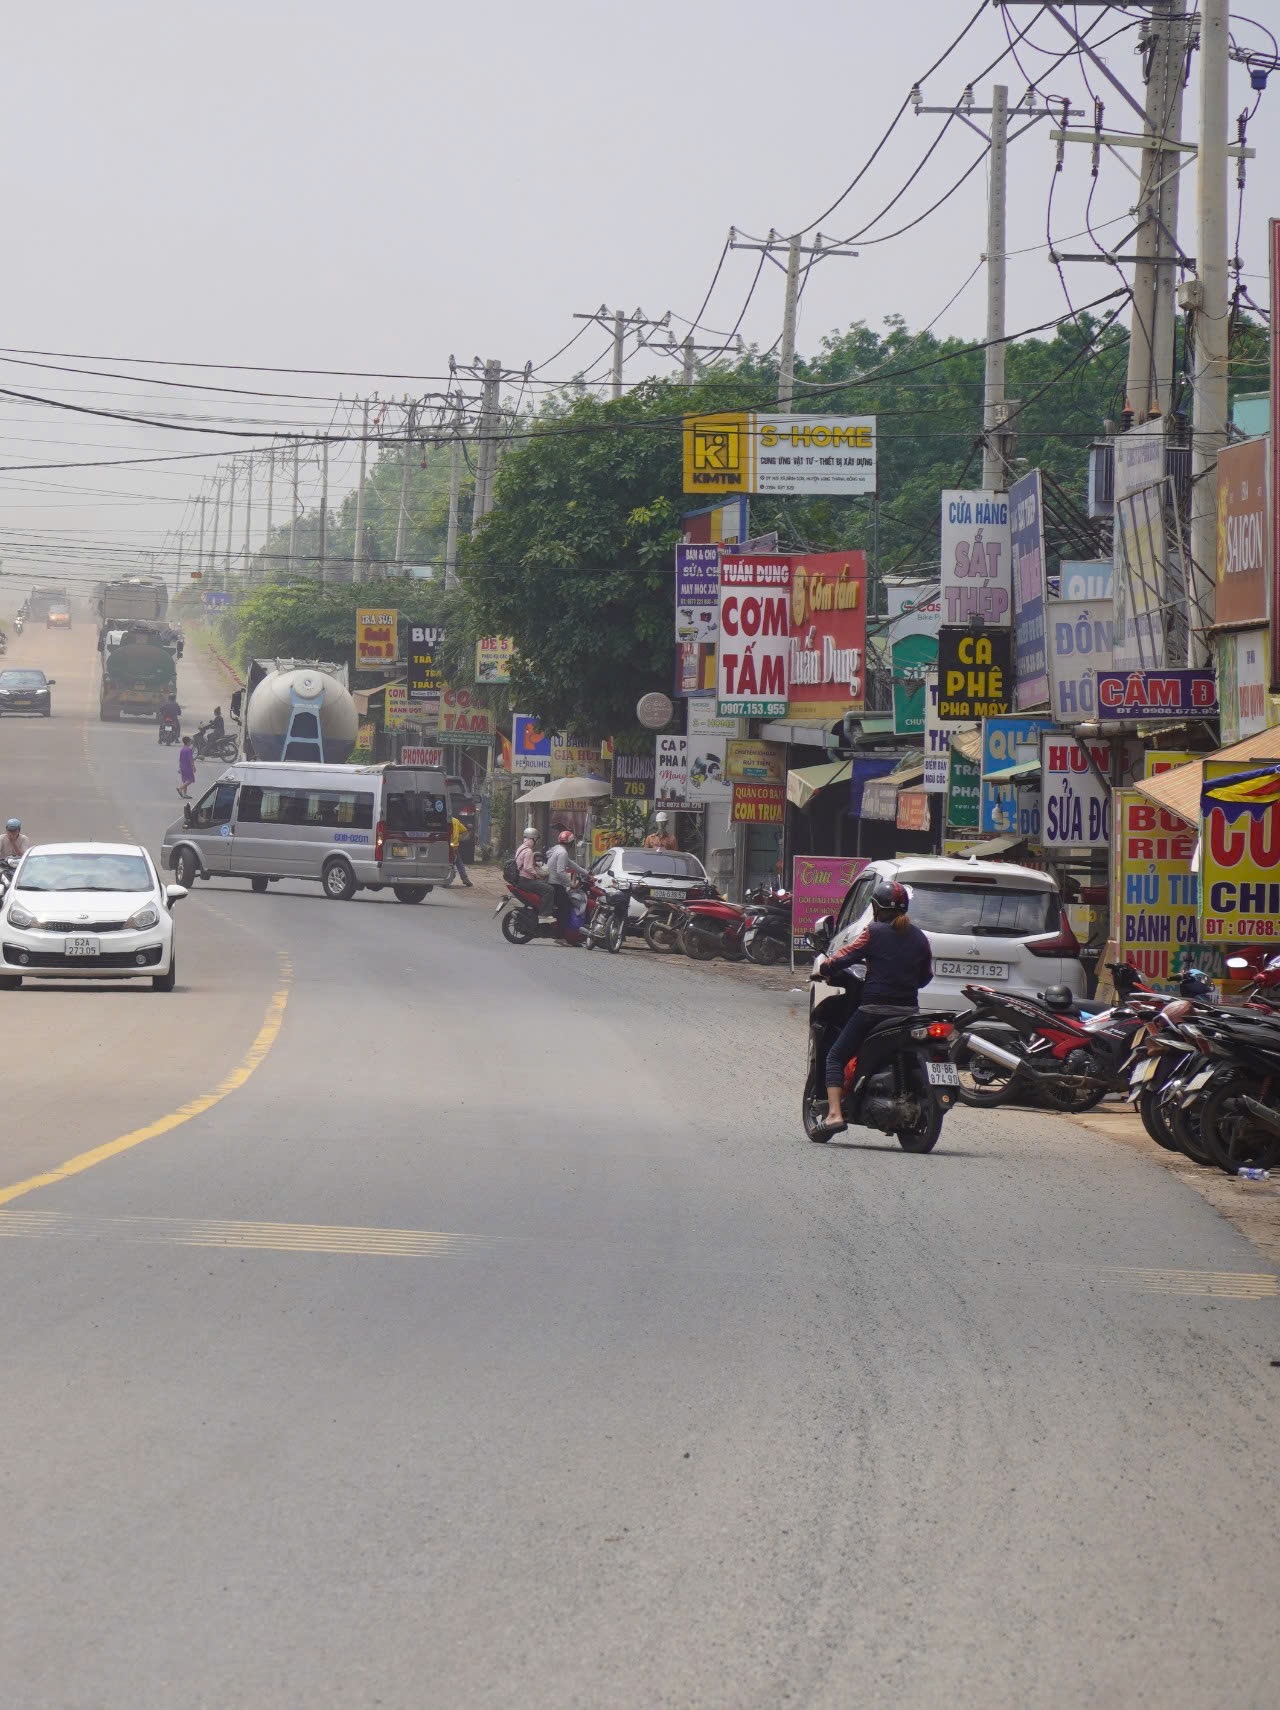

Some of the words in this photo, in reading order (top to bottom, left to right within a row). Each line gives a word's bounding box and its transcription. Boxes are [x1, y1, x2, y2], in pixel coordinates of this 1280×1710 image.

[760, 424, 873, 449] S-HOME
[949, 495, 972, 525] CỬA
[975, 498, 1008, 525] HÀNG
[704, 549, 717, 561] CHO
[954, 527, 1001, 579] SẮT
[1227, 511, 1263, 574] SAIGON
[683, 562, 704, 578] SỬA
[723, 559, 754, 582] TUẤN
[756, 565, 789, 584] DUNG
[945, 579, 1009, 623] THÉP
[722, 596, 789, 637] CƠM
[1056, 609, 1113, 657] ĐỒN
[723, 641, 785, 695] TẤM
[822, 635, 862, 697] Dung
[946, 665, 1003, 698] PHÊ
[1099, 670, 1181, 707] CẦM
[721, 703, 786, 715] 0907.153.955
[940, 702, 970, 716] PHA
[974, 699, 1009, 717] MÁY
[905, 718, 926, 727] CHUY
[403, 748, 442, 765] PHOTOCOPY
[624, 781, 645, 796] 769
[1047, 778, 1083, 841] SỬA
[1128, 833, 1195, 861] RIÊ
[1126, 863, 1160, 905] HỦ
[1125, 908, 1171, 943] BÁNH
[1176, 915, 1198, 943] CA
[68, 946, 96, 955] 273.05
[74, 938, 90, 947] 62A
[941, 963, 1003, 977] 62A-291.92
[1125, 951, 1169, 979] NUI
